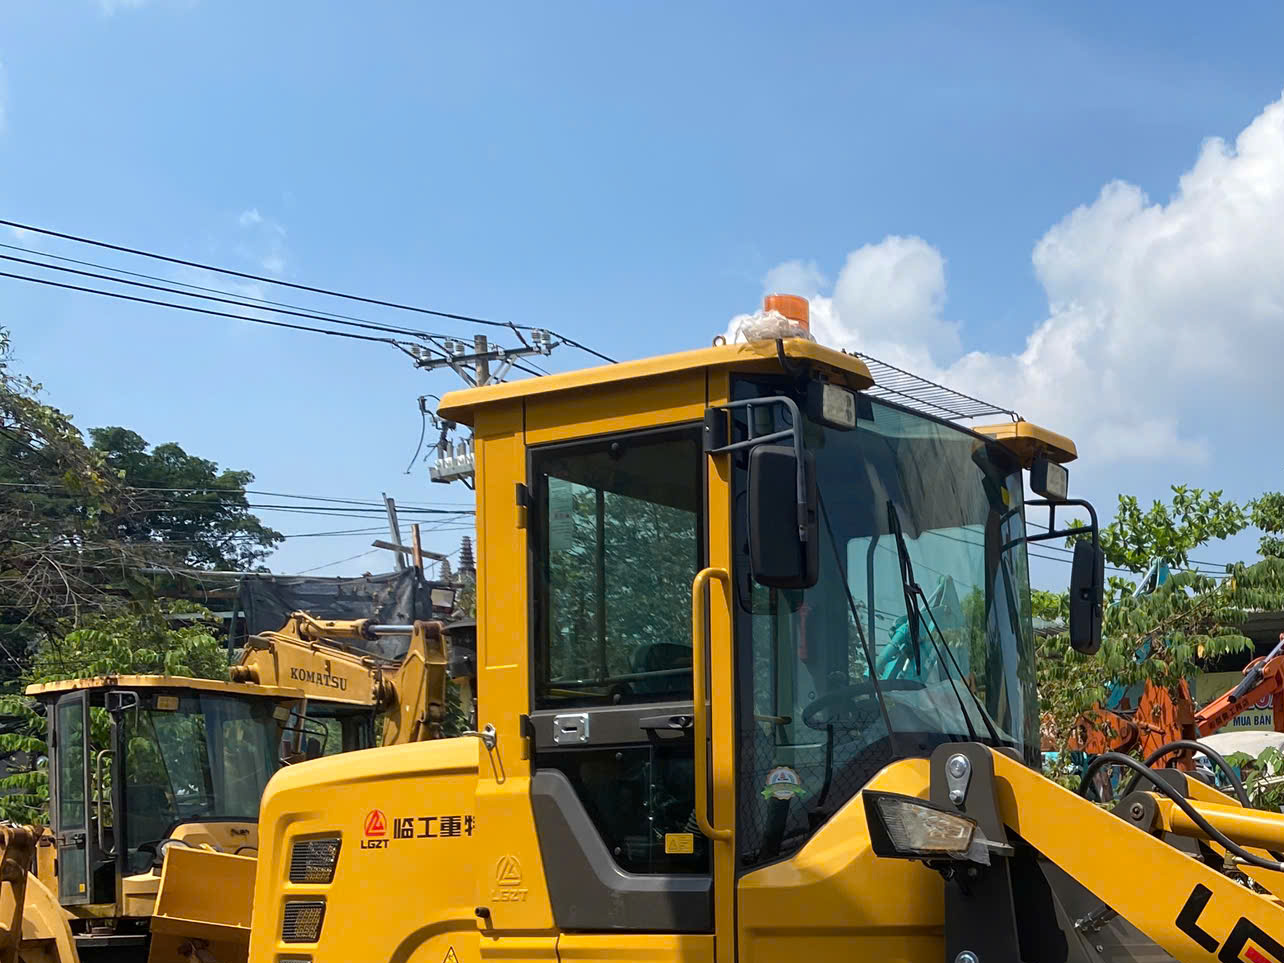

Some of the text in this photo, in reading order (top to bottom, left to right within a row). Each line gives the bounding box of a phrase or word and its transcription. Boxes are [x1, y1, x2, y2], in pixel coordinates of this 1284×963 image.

[290, 667, 347, 691] KOMATSU
[1233, 716, 1251, 726] MUA
[361, 839, 389, 849] LGZT
